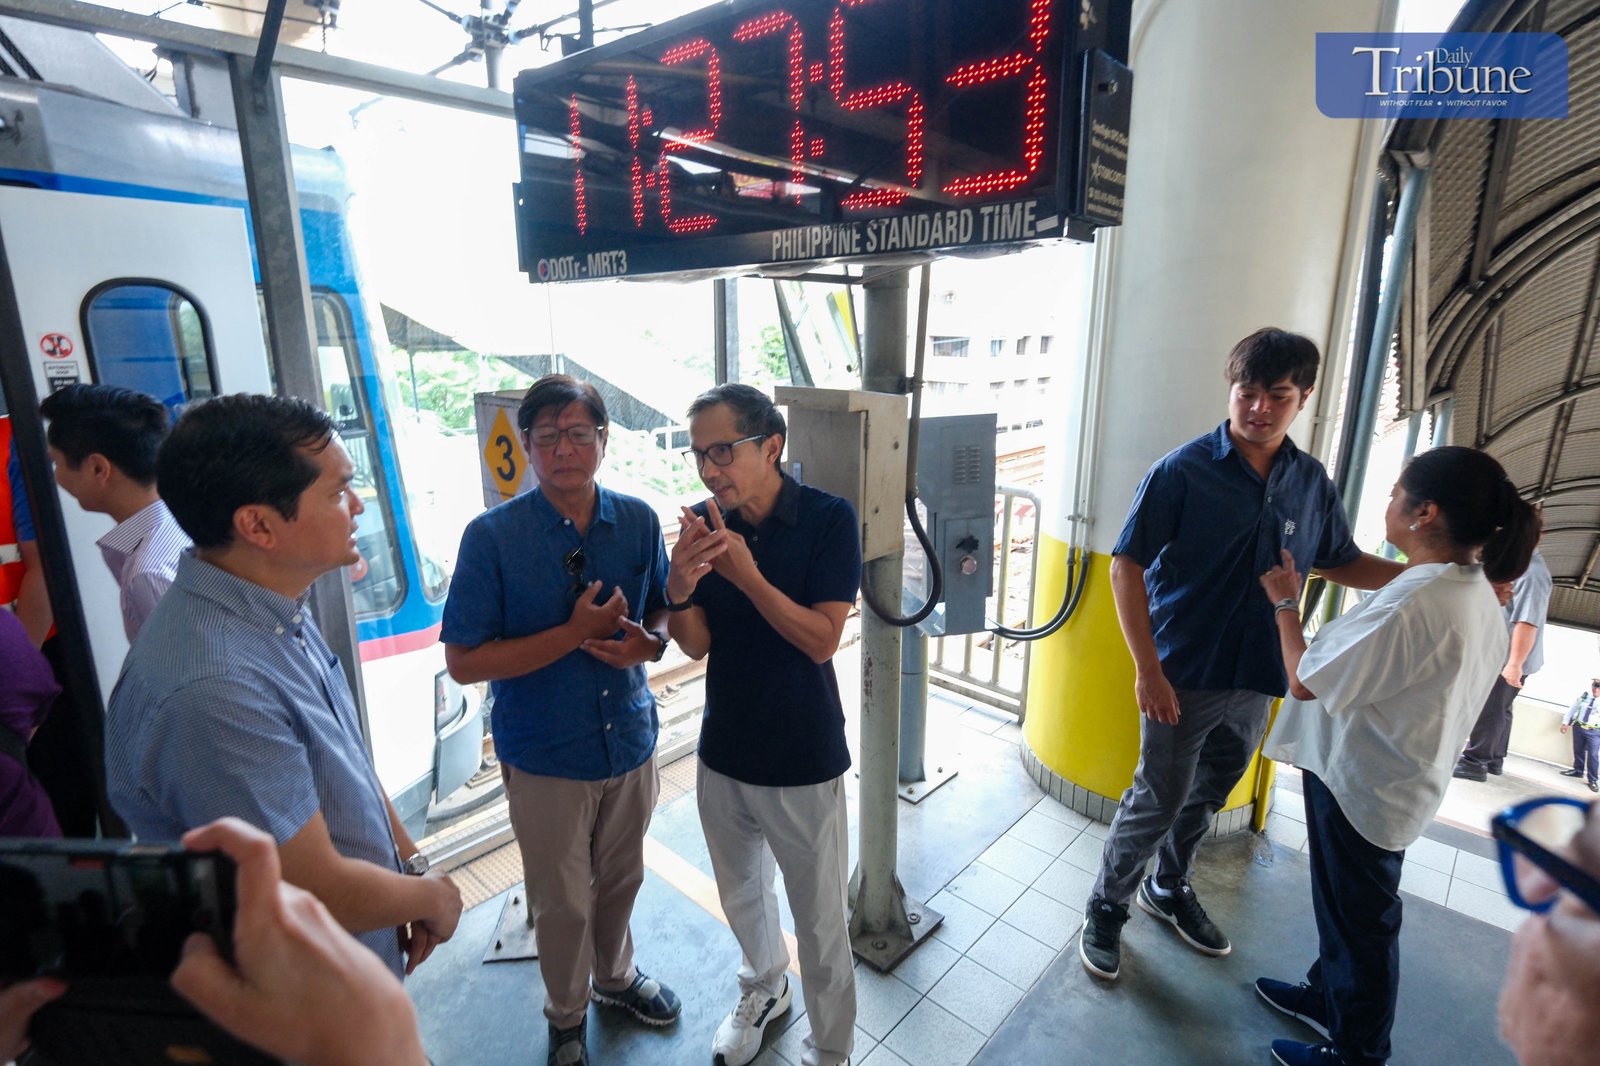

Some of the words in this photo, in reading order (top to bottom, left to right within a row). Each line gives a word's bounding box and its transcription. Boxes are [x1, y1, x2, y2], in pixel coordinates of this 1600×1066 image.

[772, 221, 862, 261] PHILIPPINE
[866, 208, 974, 253] STANDARD
[979, 200, 1038, 243] TIME
[495, 434, 516, 482] 3
